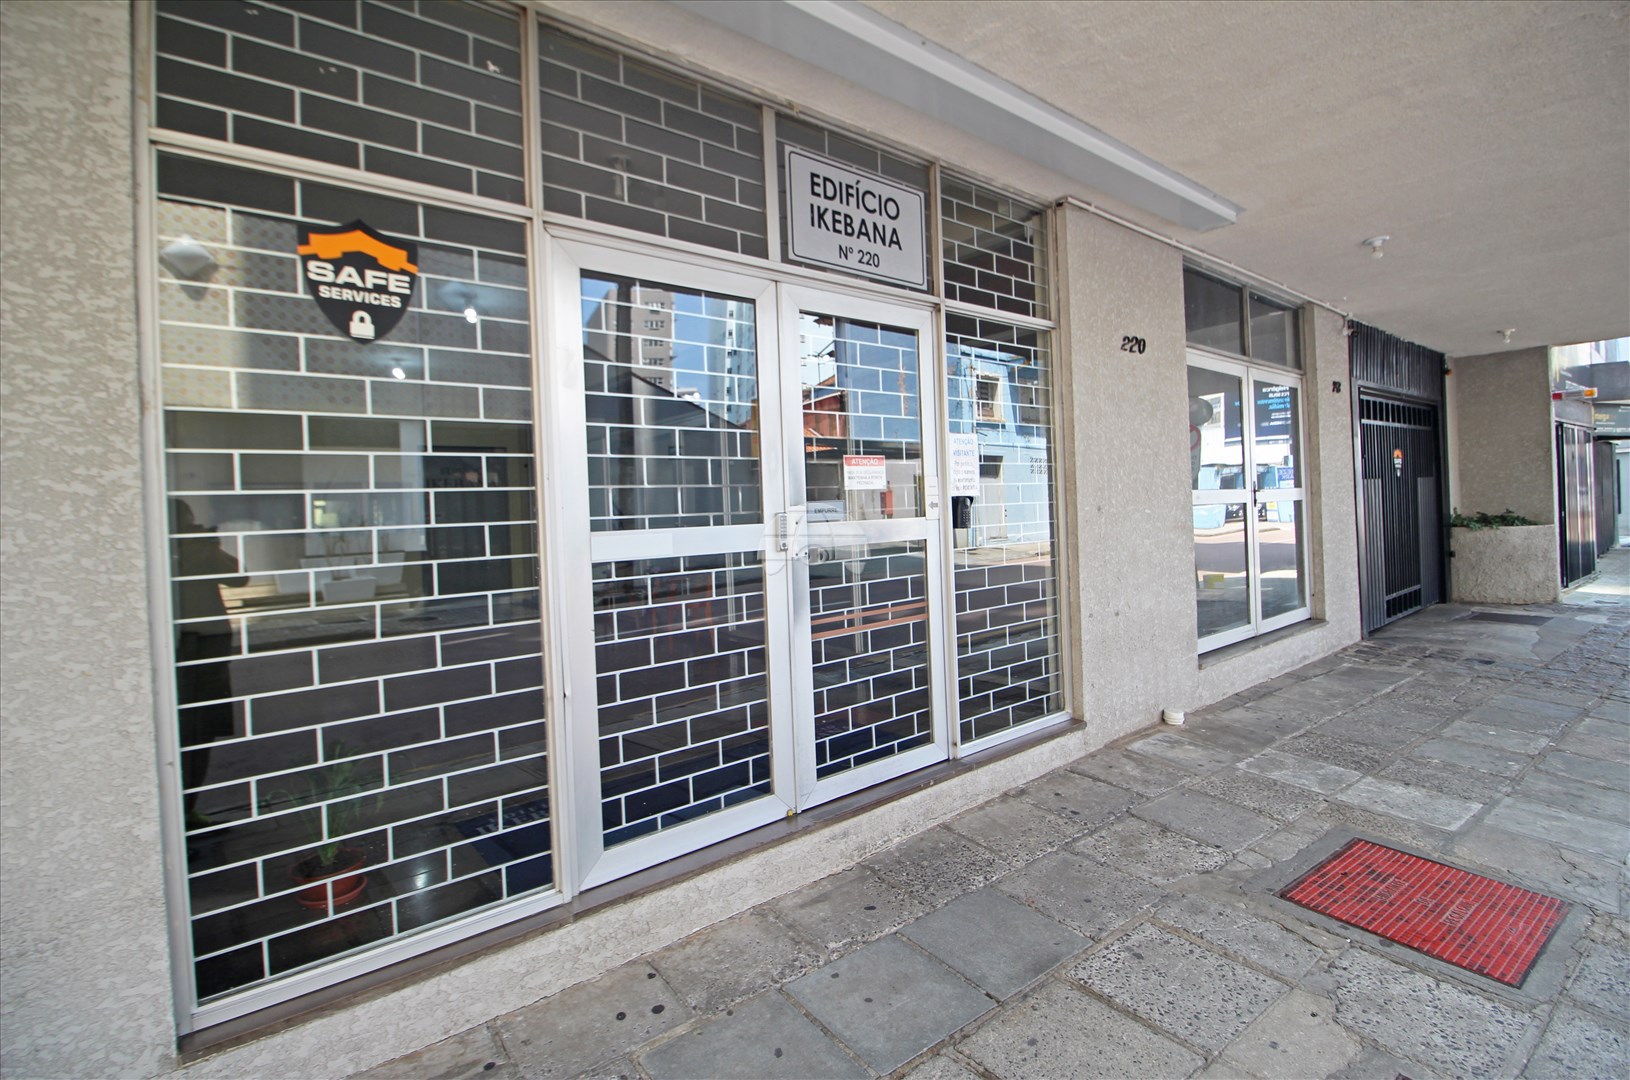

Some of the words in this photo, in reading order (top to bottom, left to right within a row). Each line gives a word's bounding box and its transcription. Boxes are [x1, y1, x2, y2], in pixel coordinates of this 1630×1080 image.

[810, 172, 900, 221] EDIFÍCIO
[810, 203, 903, 251] IKEBANA
[857, 249, 880, 268] 220
[307, 260, 411, 295] SAFE
[318, 284, 402, 308] SERVICES
[1120, 335, 1146, 355] 220
[851, 458, 879, 466] ATENÇÃO
